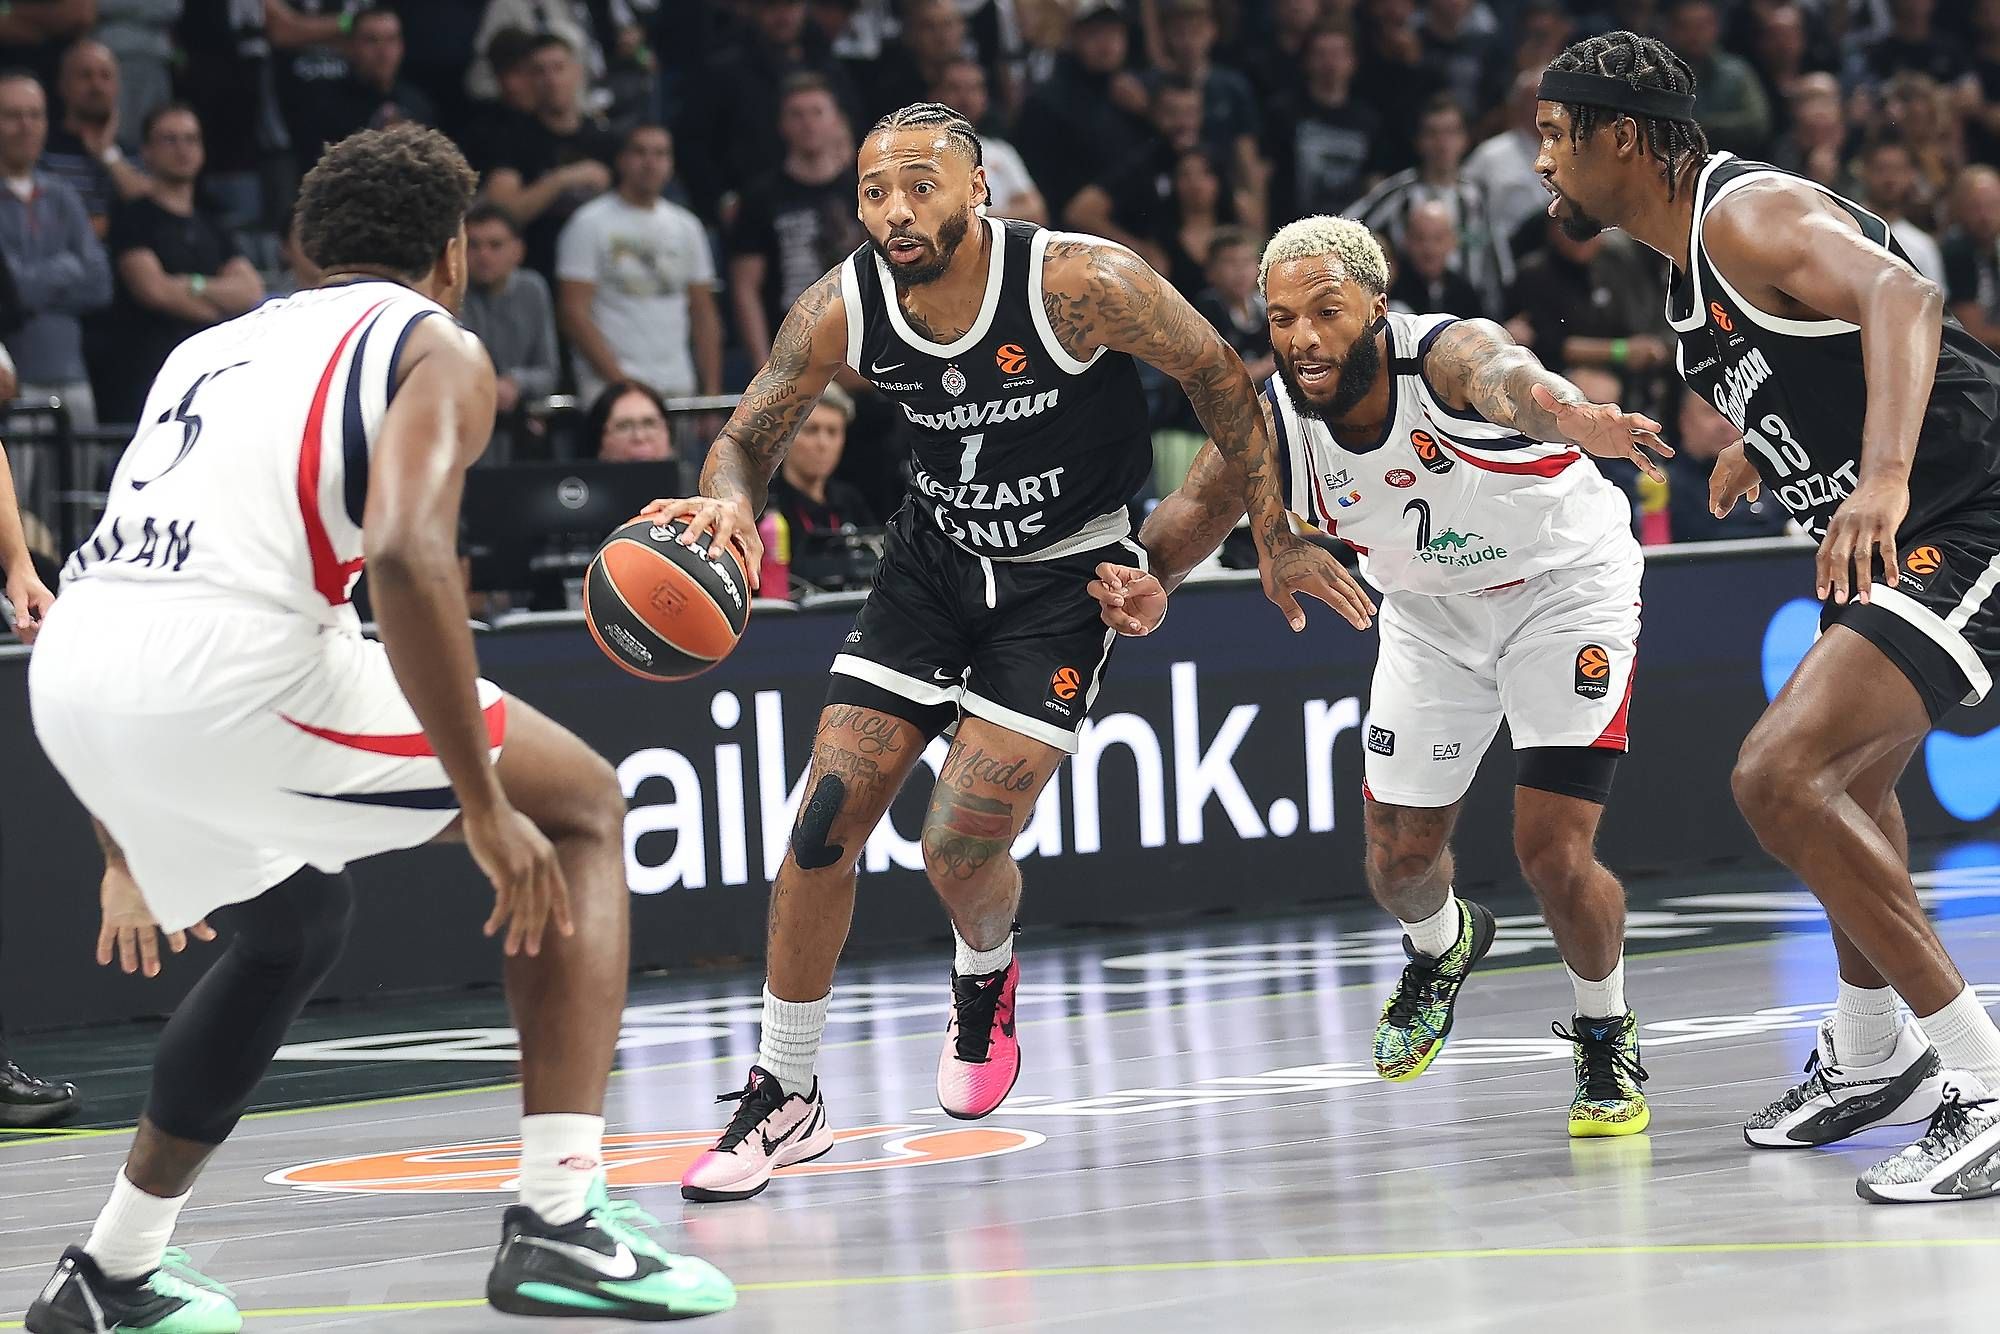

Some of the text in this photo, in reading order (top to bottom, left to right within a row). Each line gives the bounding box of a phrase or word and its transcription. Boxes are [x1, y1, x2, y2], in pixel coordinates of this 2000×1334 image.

[880, 381, 924, 391] AikBank
[131, 360, 251, 490] 5
[1743, 413, 1811, 478] 13
[958, 433, 985, 483] 1
[1323, 468, 1348, 486] EA7
[68, 515, 195, 572] ILAN
[1899, 574, 1925, 592] TIHAD
[1576, 685, 1607, 693] ETIHAD
[1045, 700, 1071, 716] ETIHAD
[1369, 727, 1392, 745] EA7
[1433, 742, 1461, 756] EA7
